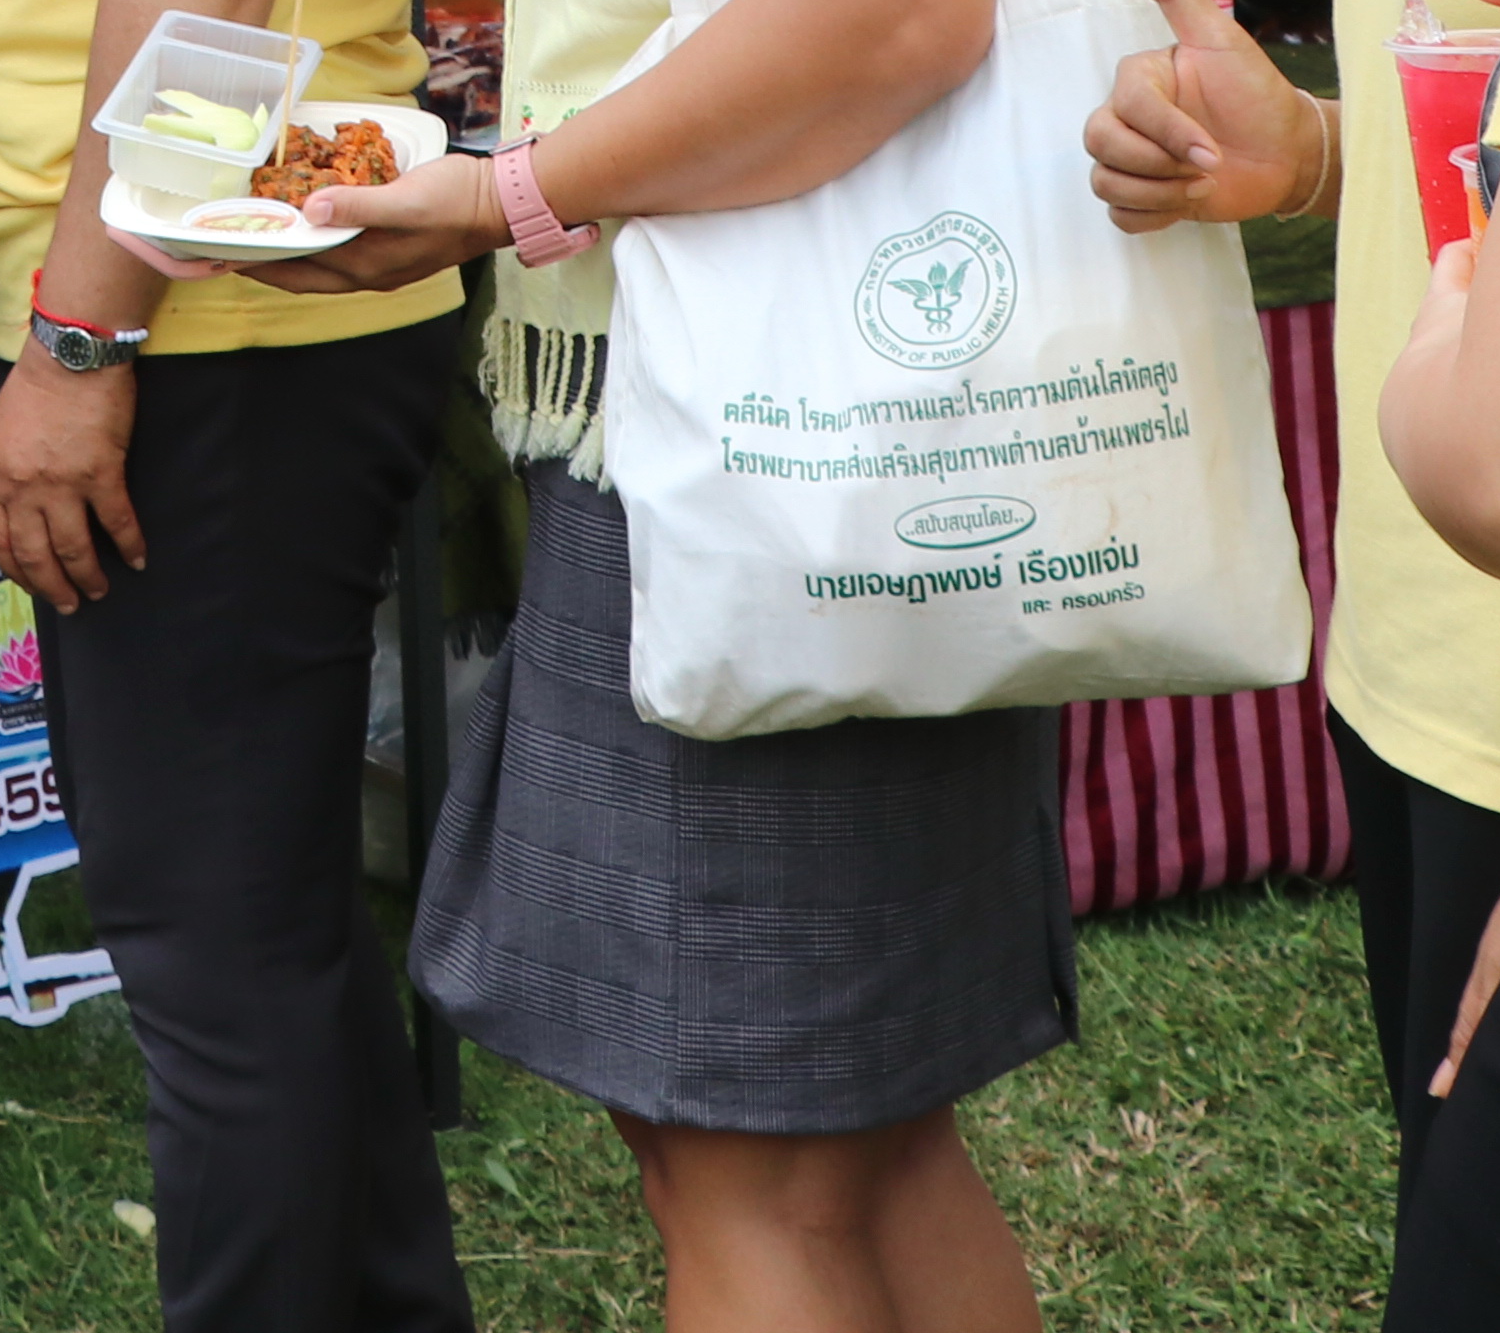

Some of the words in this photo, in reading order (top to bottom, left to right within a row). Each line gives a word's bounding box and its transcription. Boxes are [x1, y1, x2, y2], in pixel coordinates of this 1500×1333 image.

[864, 316, 909, 358] MINISTRY
[908, 350, 927, 364] OF
[931, 335, 983, 364] PUBLIC
[979, 286, 1010, 339] HEALTH
[1018, 535, 1140, 585] เรืองแจ่ม
[1022, 598, 1052, 614] และ
[1061, 581, 1146, 611] ครอบครัว
